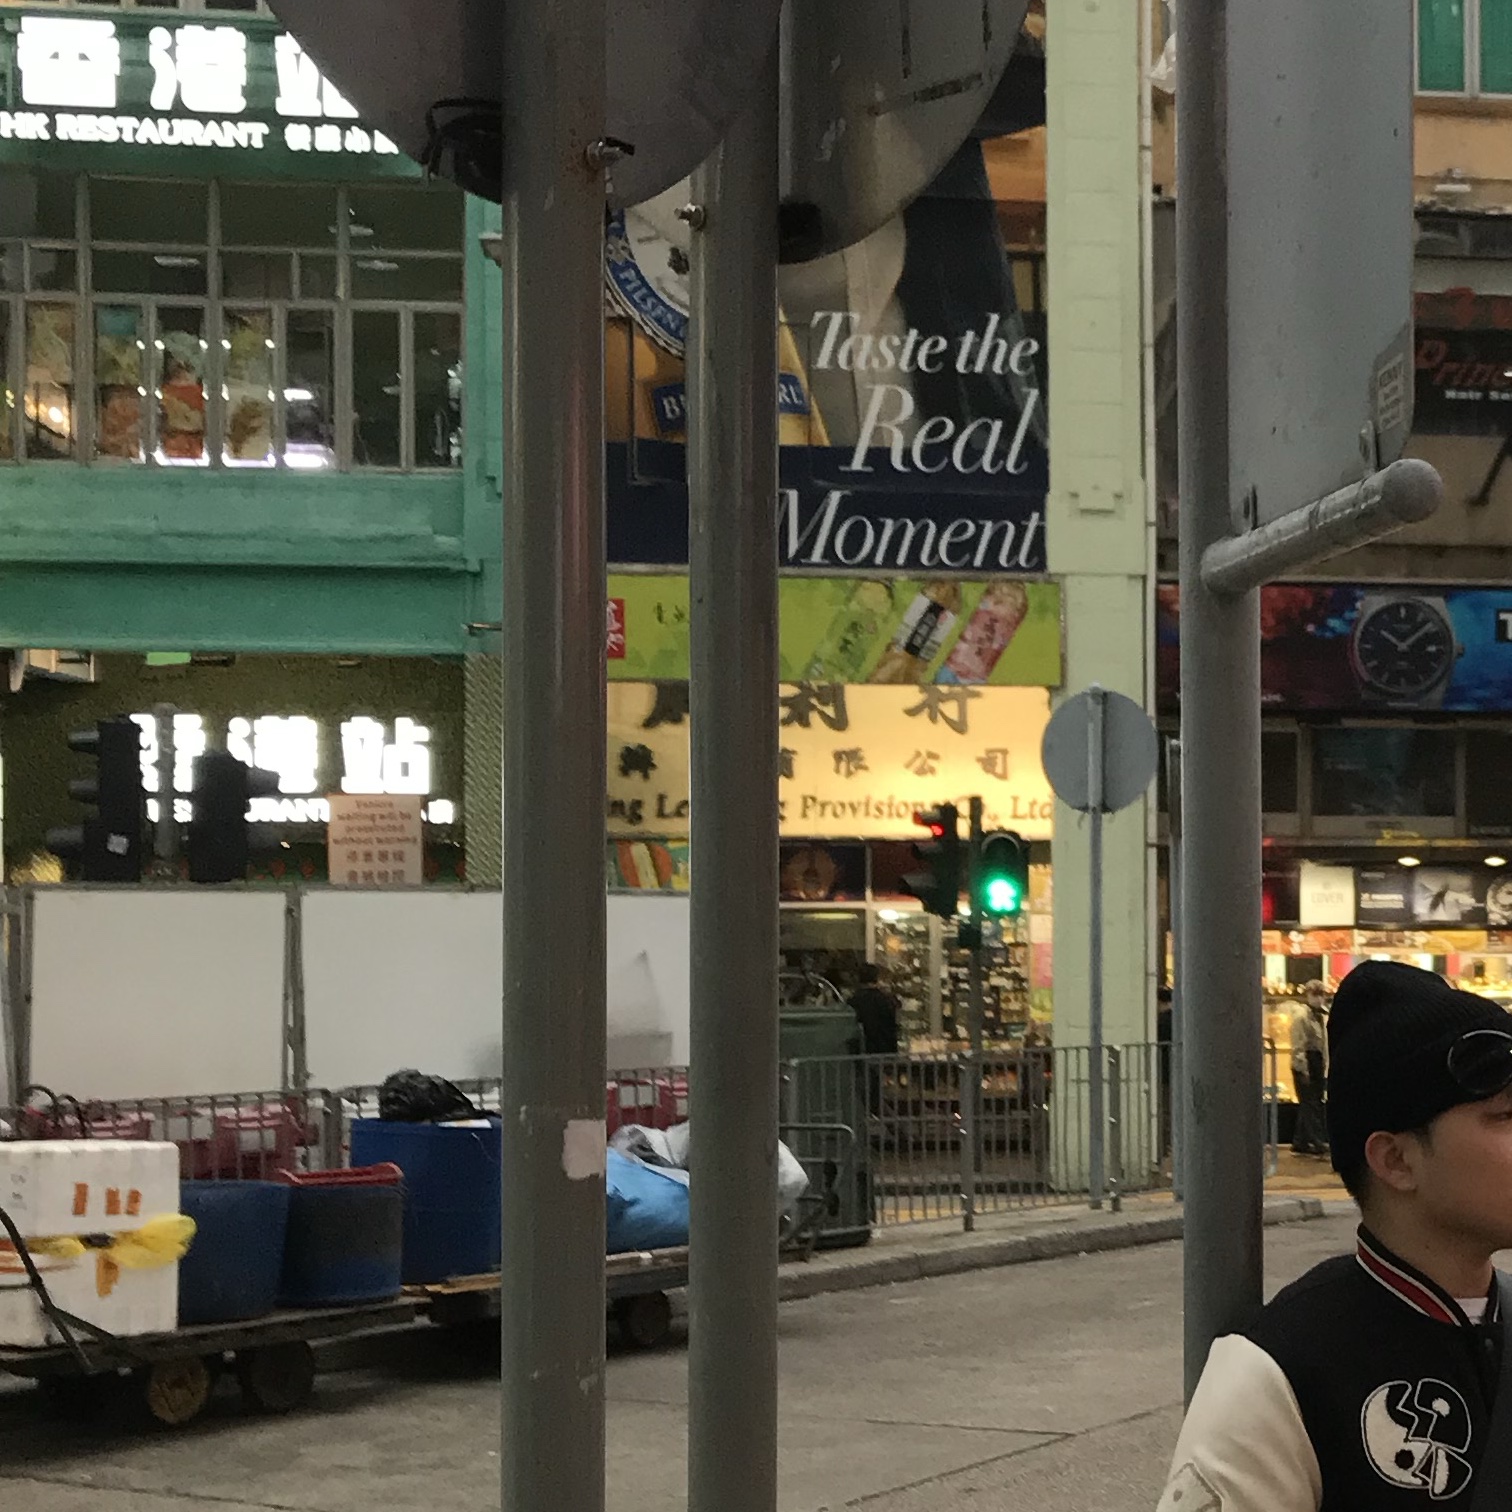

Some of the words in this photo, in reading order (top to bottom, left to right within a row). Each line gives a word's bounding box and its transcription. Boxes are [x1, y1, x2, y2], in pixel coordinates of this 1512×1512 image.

[0, 112, 50, 140] HK
[55, 113, 269, 149] RESTAURANT
[810, 311, 948, 373] Taste
[954, 312, 1040, 375] the
[838, 384, 1040, 475] Real
[778, 487, 1046, 568] Moment
